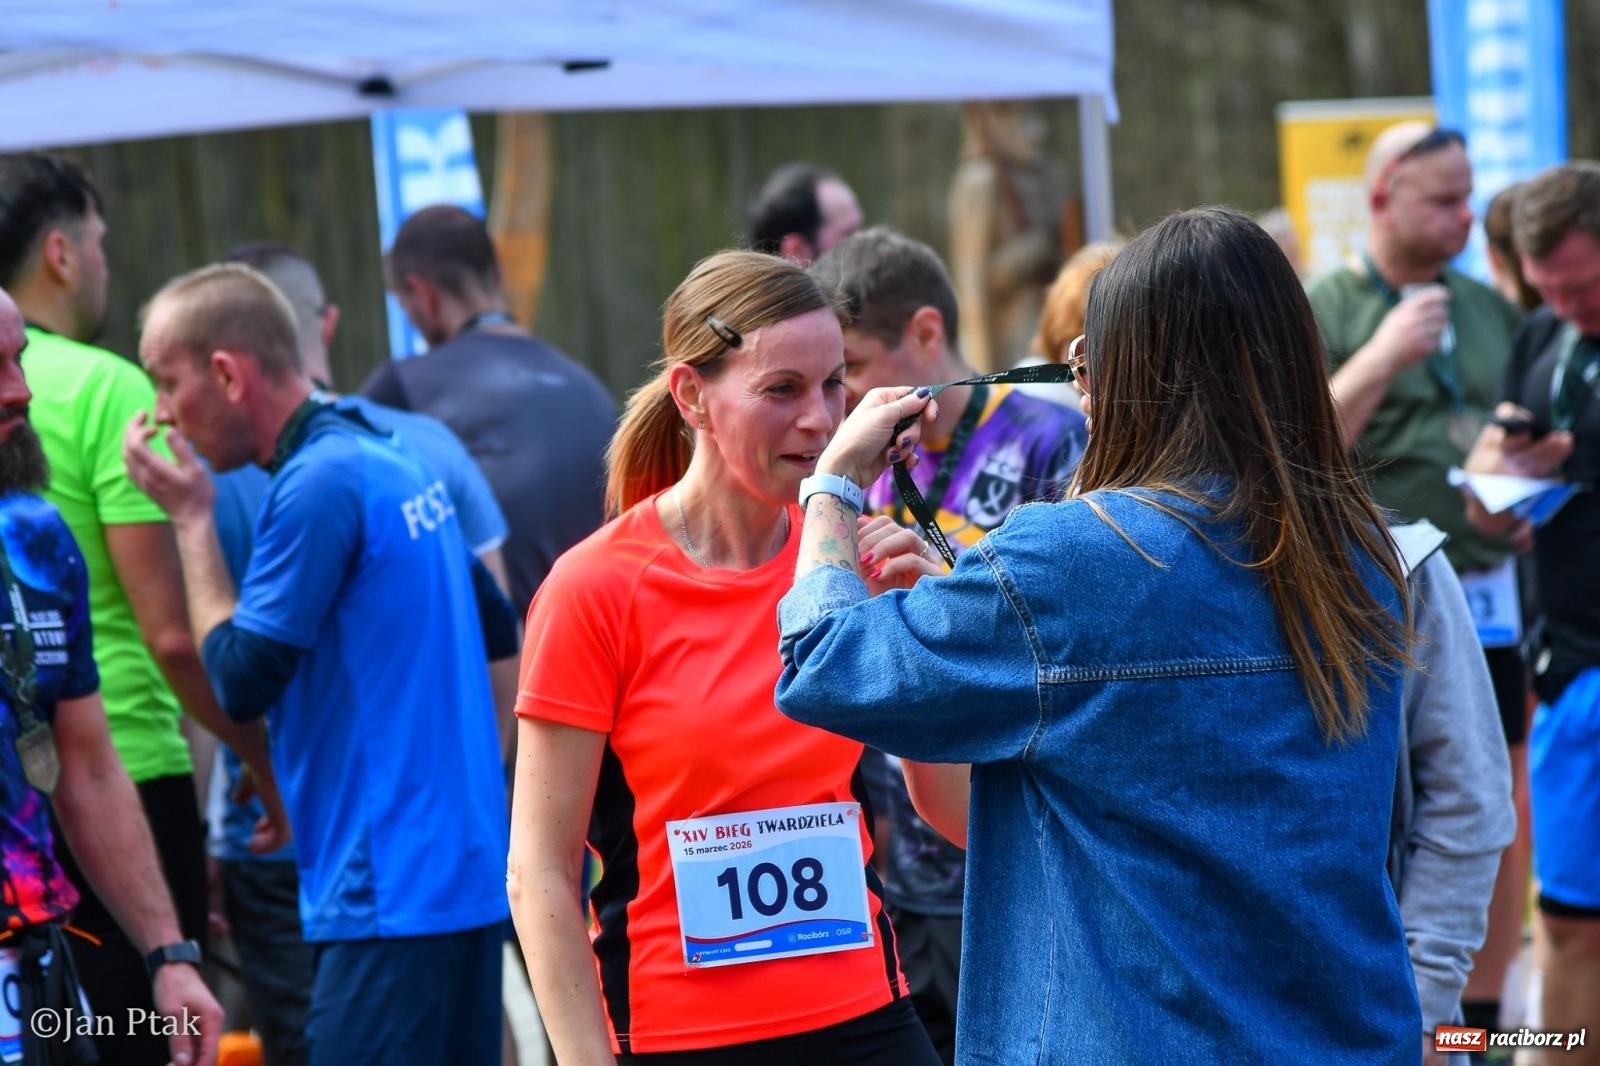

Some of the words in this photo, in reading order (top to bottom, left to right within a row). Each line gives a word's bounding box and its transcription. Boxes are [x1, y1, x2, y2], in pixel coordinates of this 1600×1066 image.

[682, 828, 708, 843] XIV
[715, 823, 751, 839] BIEG
[757, 813, 845, 834] TWARDZIELA
[684, 847, 694, 856] 15
[696, 844, 728, 854] marzec
[730, 840, 753, 850] 2026
[716, 857, 829, 920] 108
[797, 931, 829, 942] Racibórz
